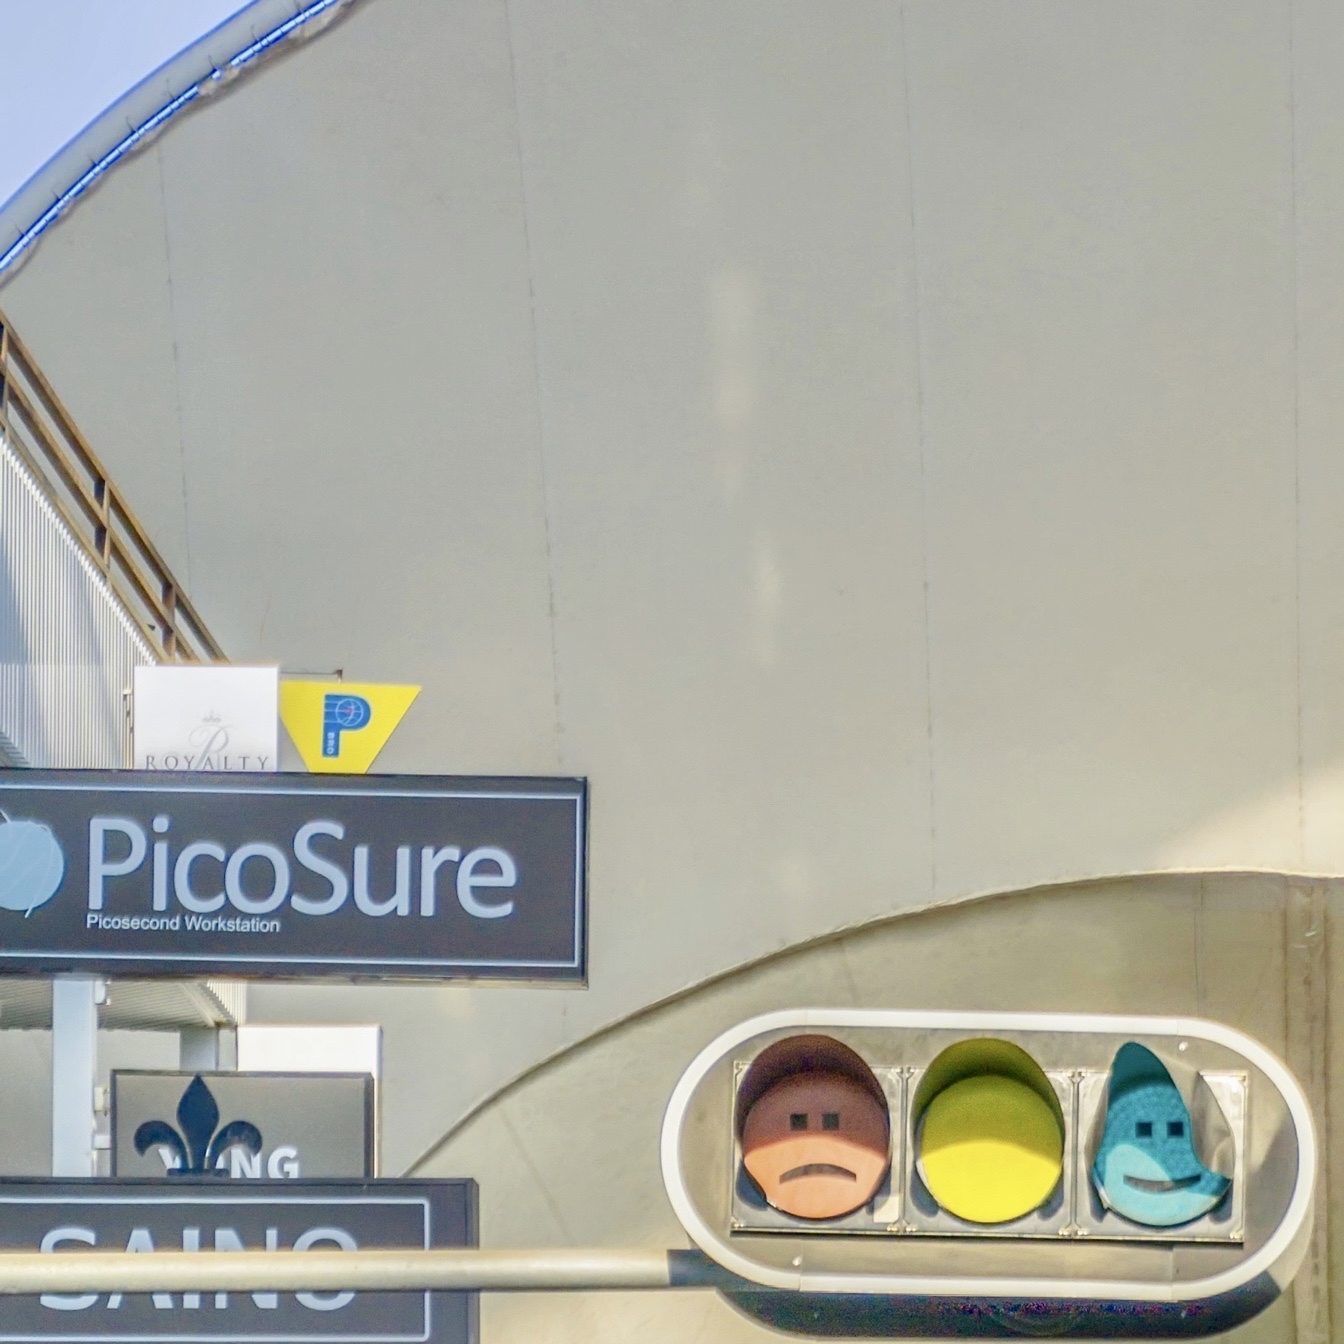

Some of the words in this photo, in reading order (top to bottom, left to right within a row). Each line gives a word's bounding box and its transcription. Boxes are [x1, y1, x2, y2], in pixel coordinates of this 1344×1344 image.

[146, 755, 270, 770] ROYALTY
[88, 815, 517, 919] PicoSure
[86, 914, 180, 931] Picosecond
[184, 915, 280, 933] Workstation
